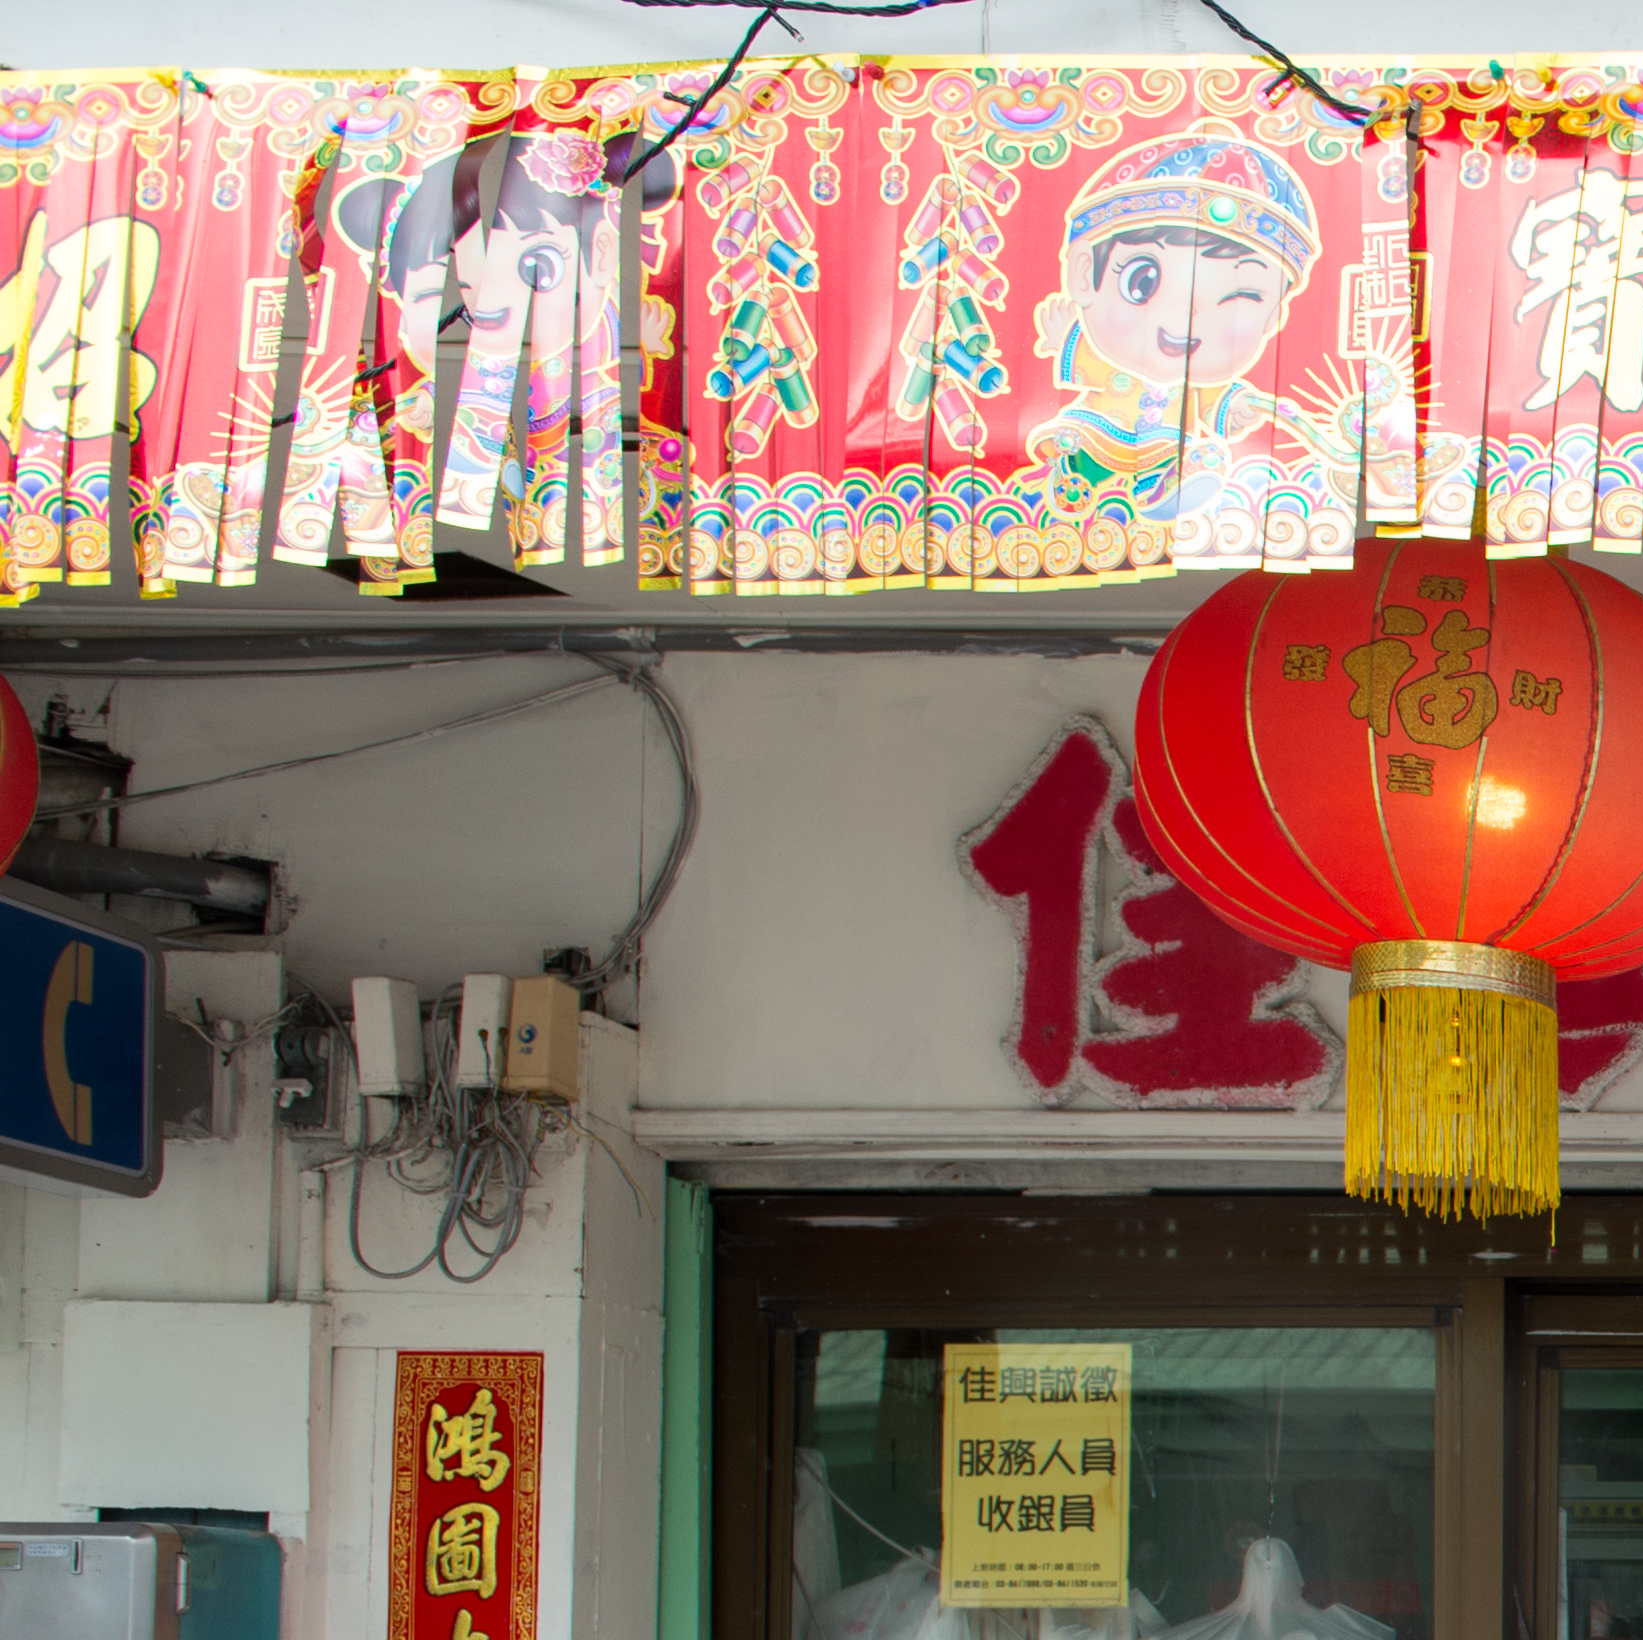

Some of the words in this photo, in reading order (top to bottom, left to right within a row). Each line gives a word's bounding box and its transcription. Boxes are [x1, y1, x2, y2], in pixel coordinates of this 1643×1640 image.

[1283, 644, 1331, 683] 發
[1343, 604, 1499, 750] 福
[1509, 669, 1563, 715] 財
[1386, 754, 1436, 796] 喜
[958, 1366, 1119, 1404] 佳興誠徵
[958, 1438, 1117, 1477] 服務人員
[977, 1494, 1096, 1533] 收銀員
